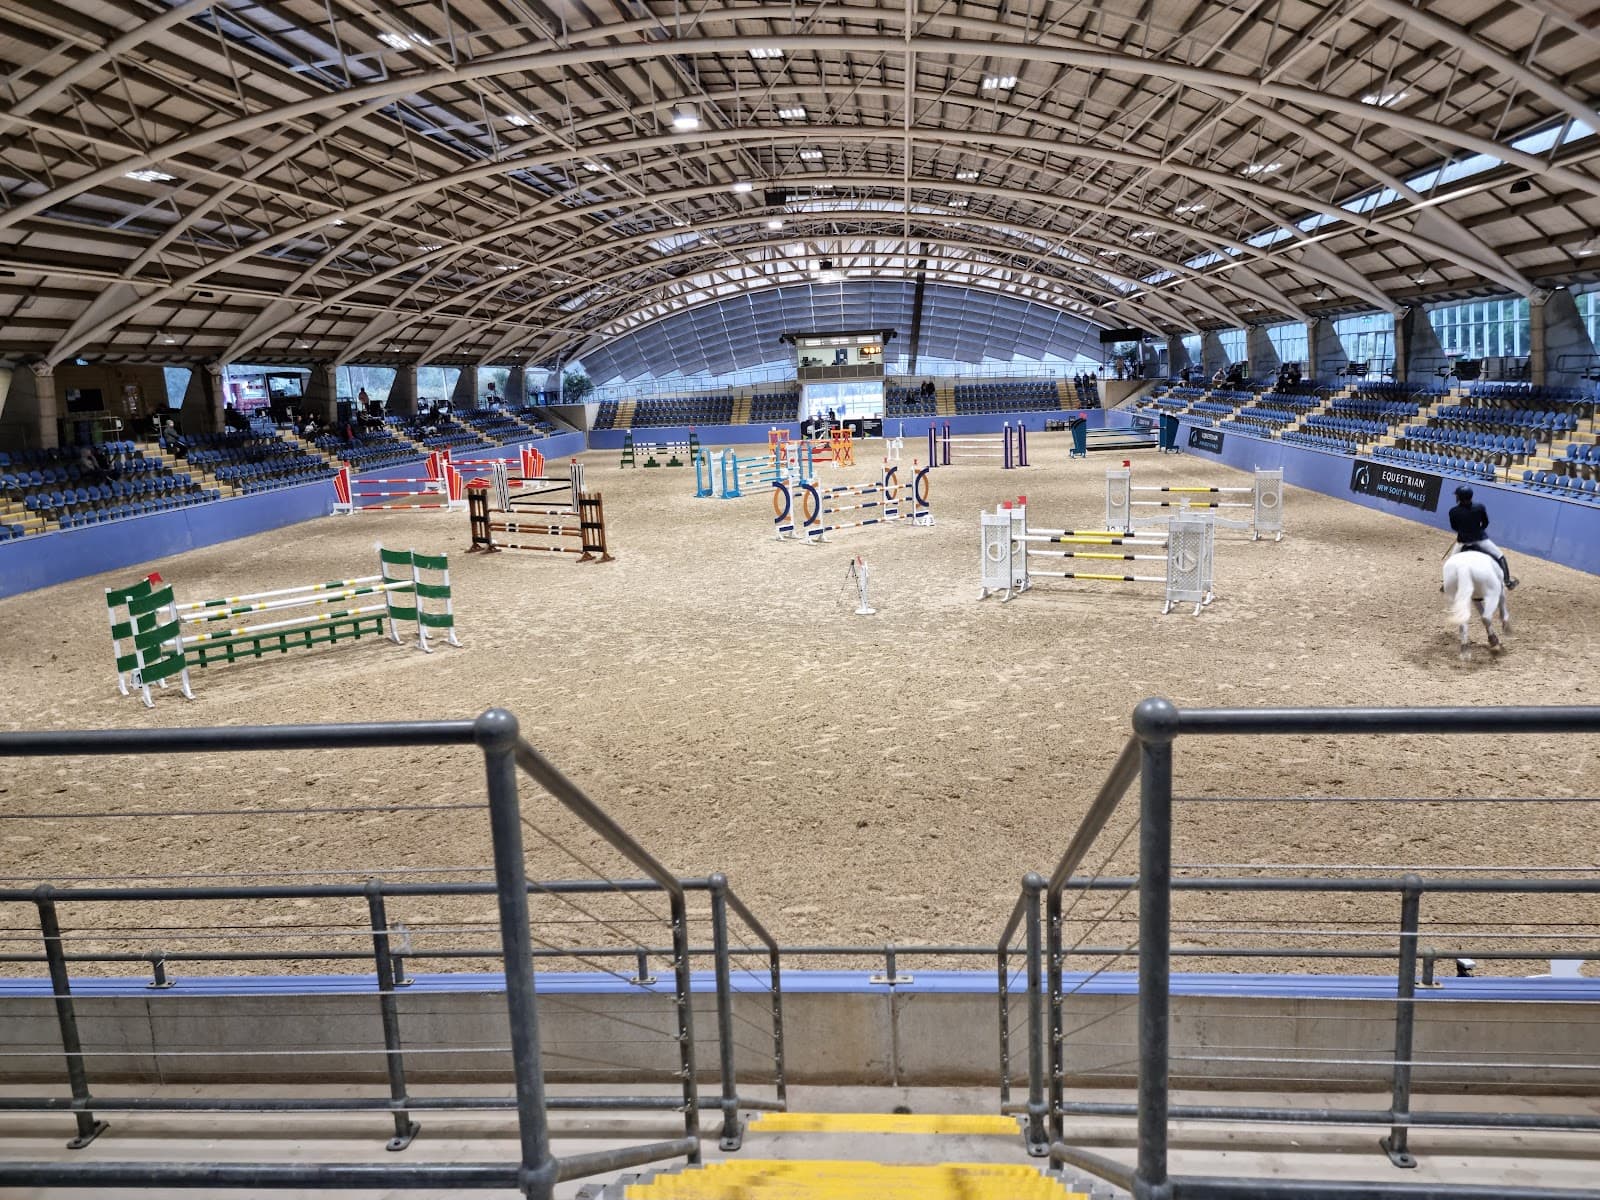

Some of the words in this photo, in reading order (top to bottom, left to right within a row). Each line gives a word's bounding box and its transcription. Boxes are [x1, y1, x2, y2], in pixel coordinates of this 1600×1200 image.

[1382, 471, 1425, 488] EQUESTRIAN
[1389, 488, 1406, 496] SOUTH
[1408, 492, 1426, 502] WALES
